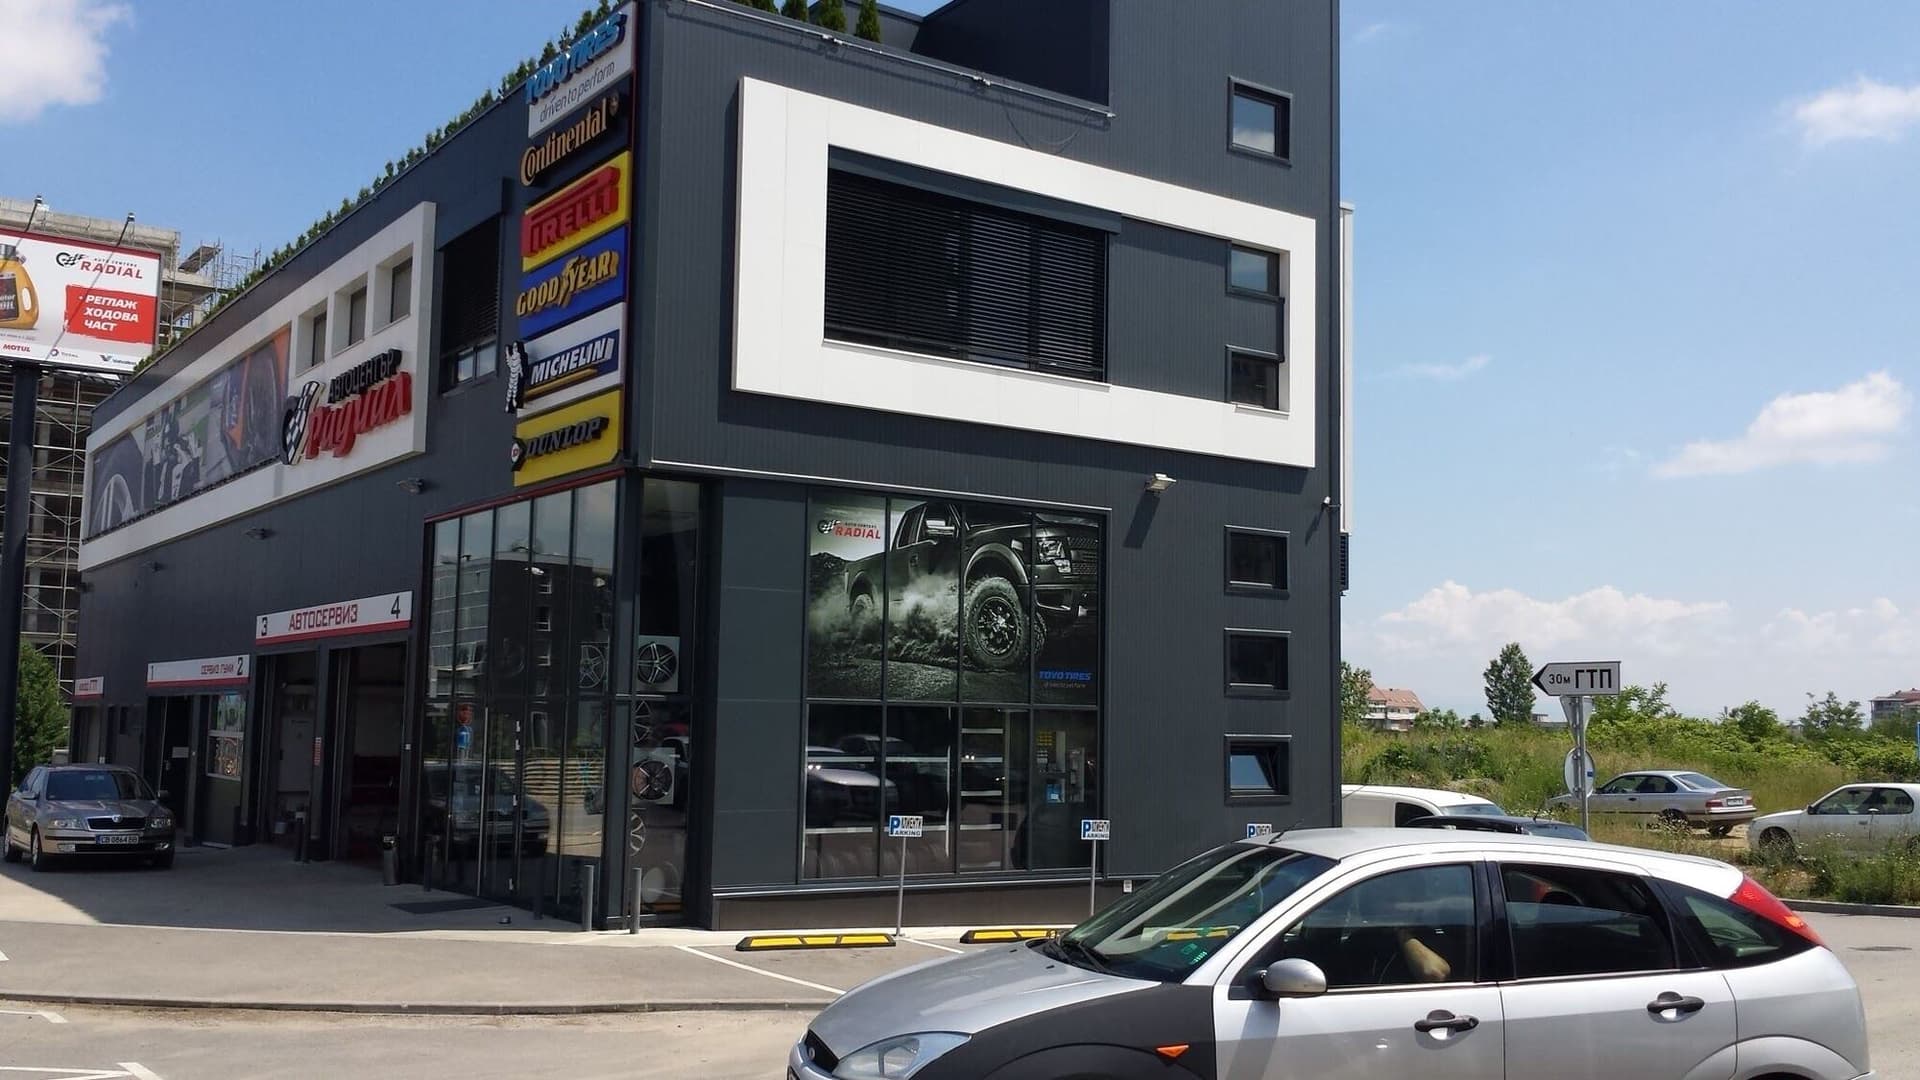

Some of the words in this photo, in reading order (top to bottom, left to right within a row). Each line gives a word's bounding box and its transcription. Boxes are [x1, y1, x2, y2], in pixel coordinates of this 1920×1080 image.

[525, 52, 572, 104] TOYO
[540, 96, 567, 122] driven
[568, 88, 578, 102] to
[578, 61, 615, 102] perform
[520, 97, 607, 187] Continental
[521, 165, 620, 257] PIRELLI
[80, 261, 143, 279] RADIAL
[516, 250, 619, 317] GOODYEAR
[84, 307, 139, 322] ХОДОВА
[85, 294, 138, 310] РЕГЛАЖ
[84, 320, 117, 332] ЧАСТ
[2, 343, 31, 353] MOTUL
[530, 337, 615, 385] MICHELIN
[328, 348, 402, 404] АВТОЦЕНТЪР
[525, 416, 608, 458] DUNLOP
[835, 525, 881, 540] RADIAL
[261, 616, 268, 637] 3
[288, 604, 358, 632] АВТОСЕРВИЗ
[391, 596, 400, 619] 4
[237, 656, 243, 676] 2
[1039, 671, 1064, 680] TOYO
[1549, 673, 1570, 685] 30м
[1575, 669, 1612, 689] ГТП
